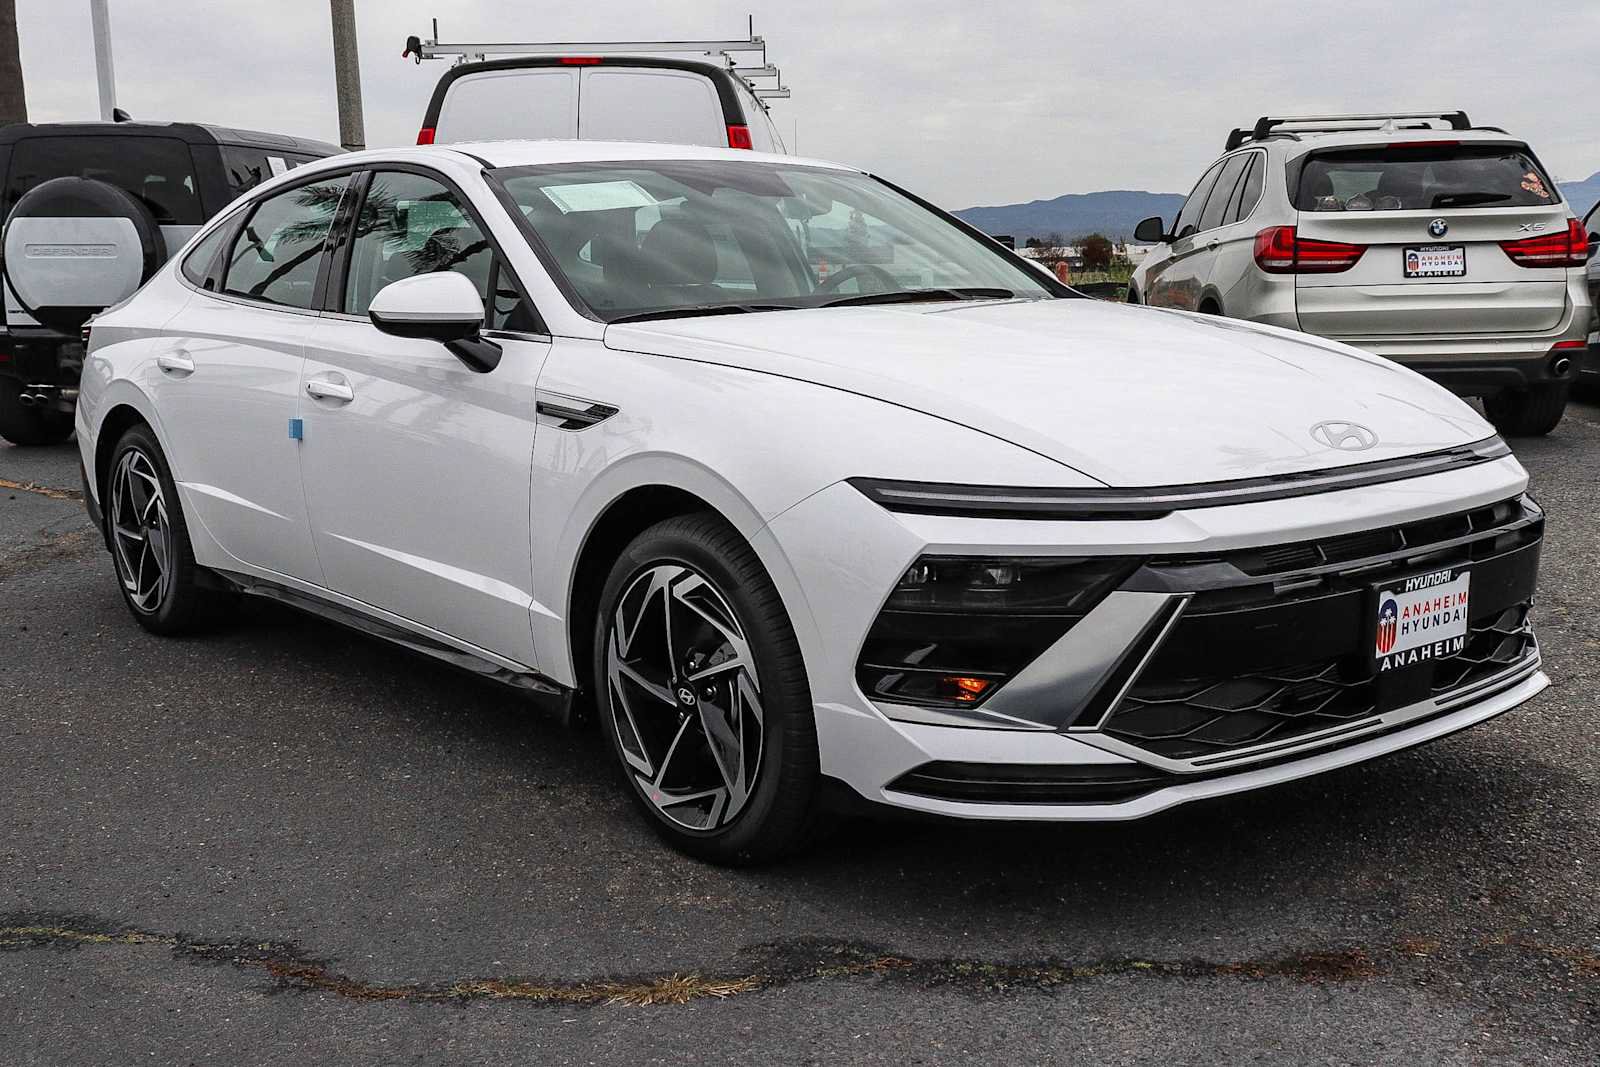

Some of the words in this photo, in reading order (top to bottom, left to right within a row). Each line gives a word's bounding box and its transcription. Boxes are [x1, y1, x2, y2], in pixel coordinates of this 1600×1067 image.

[1518, 222, 1545, 232] X5
[32, 248, 112, 256] DEFENDER
[1405, 570, 1452, 591] HYUNDAI
[1402, 592, 1466, 619] ANAHEIM
[1402, 607, 1466, 635] HYUNDAI
[1380, 636, 1464, 672] ANAHEIM
